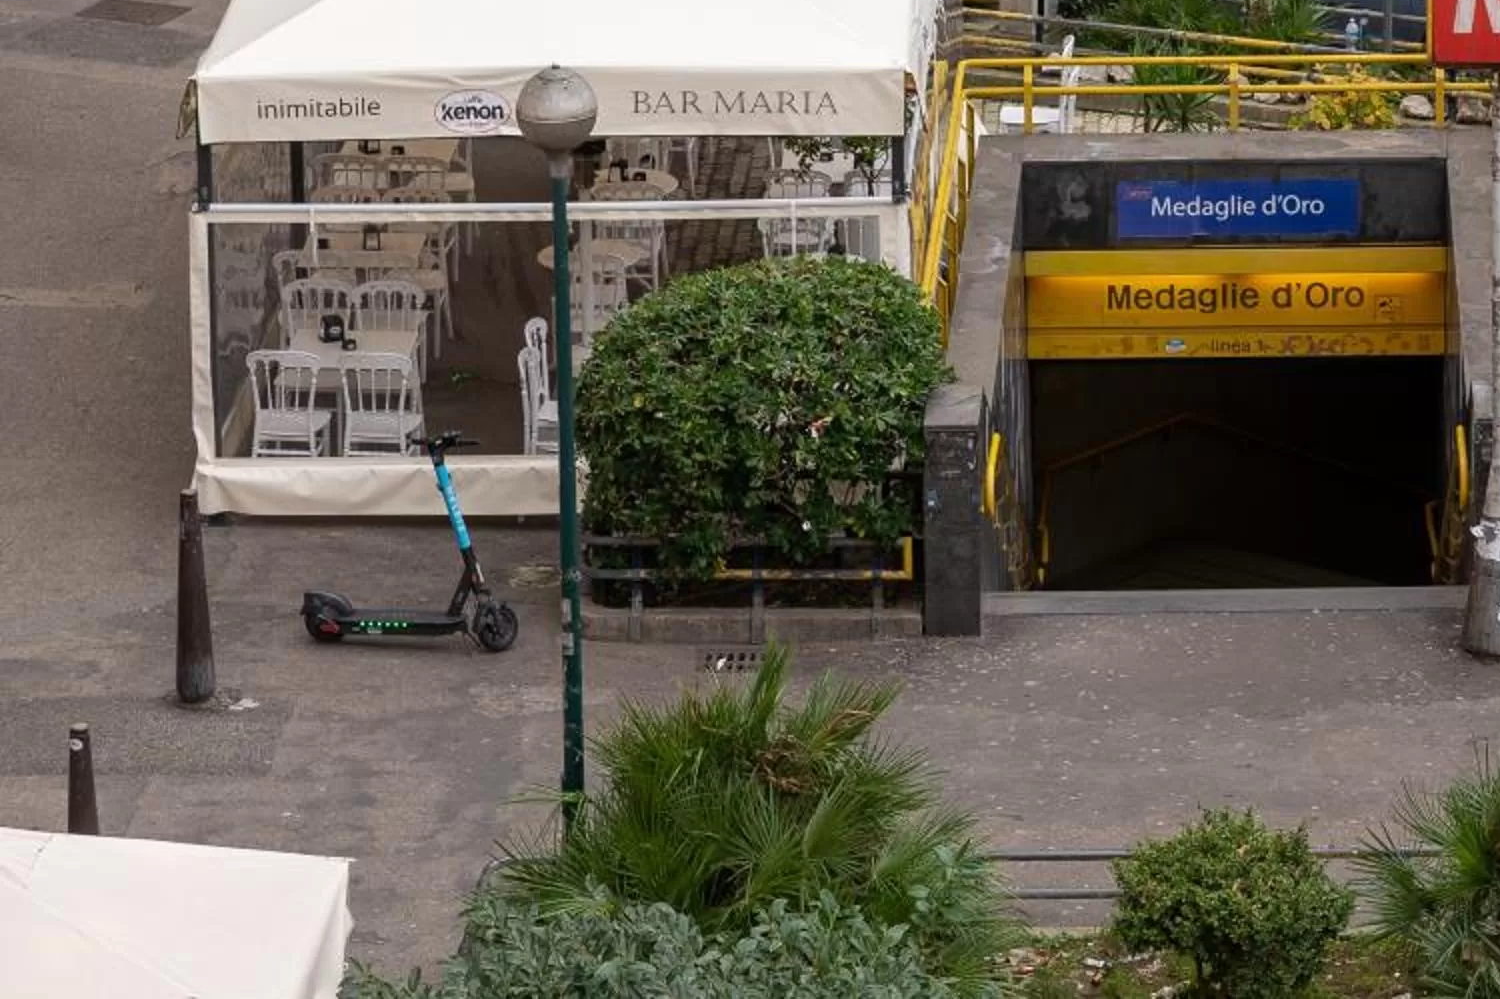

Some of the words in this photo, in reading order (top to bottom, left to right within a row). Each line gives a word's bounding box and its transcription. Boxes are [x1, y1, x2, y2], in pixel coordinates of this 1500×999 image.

[257, 97, 382, 119] inimitabile
[441, 103, 504, 121] kenon
[631, 90, 702, 115] BAR
[713, 90, 838, 116] MARIA
[1150, 196, 1256, 221] Medaglie
[1262, 194, 1326, 216] d'Oro
[1106, 282, 1260, 314] Medaglie
[1271, 281, 1366, 309] d'Oro
